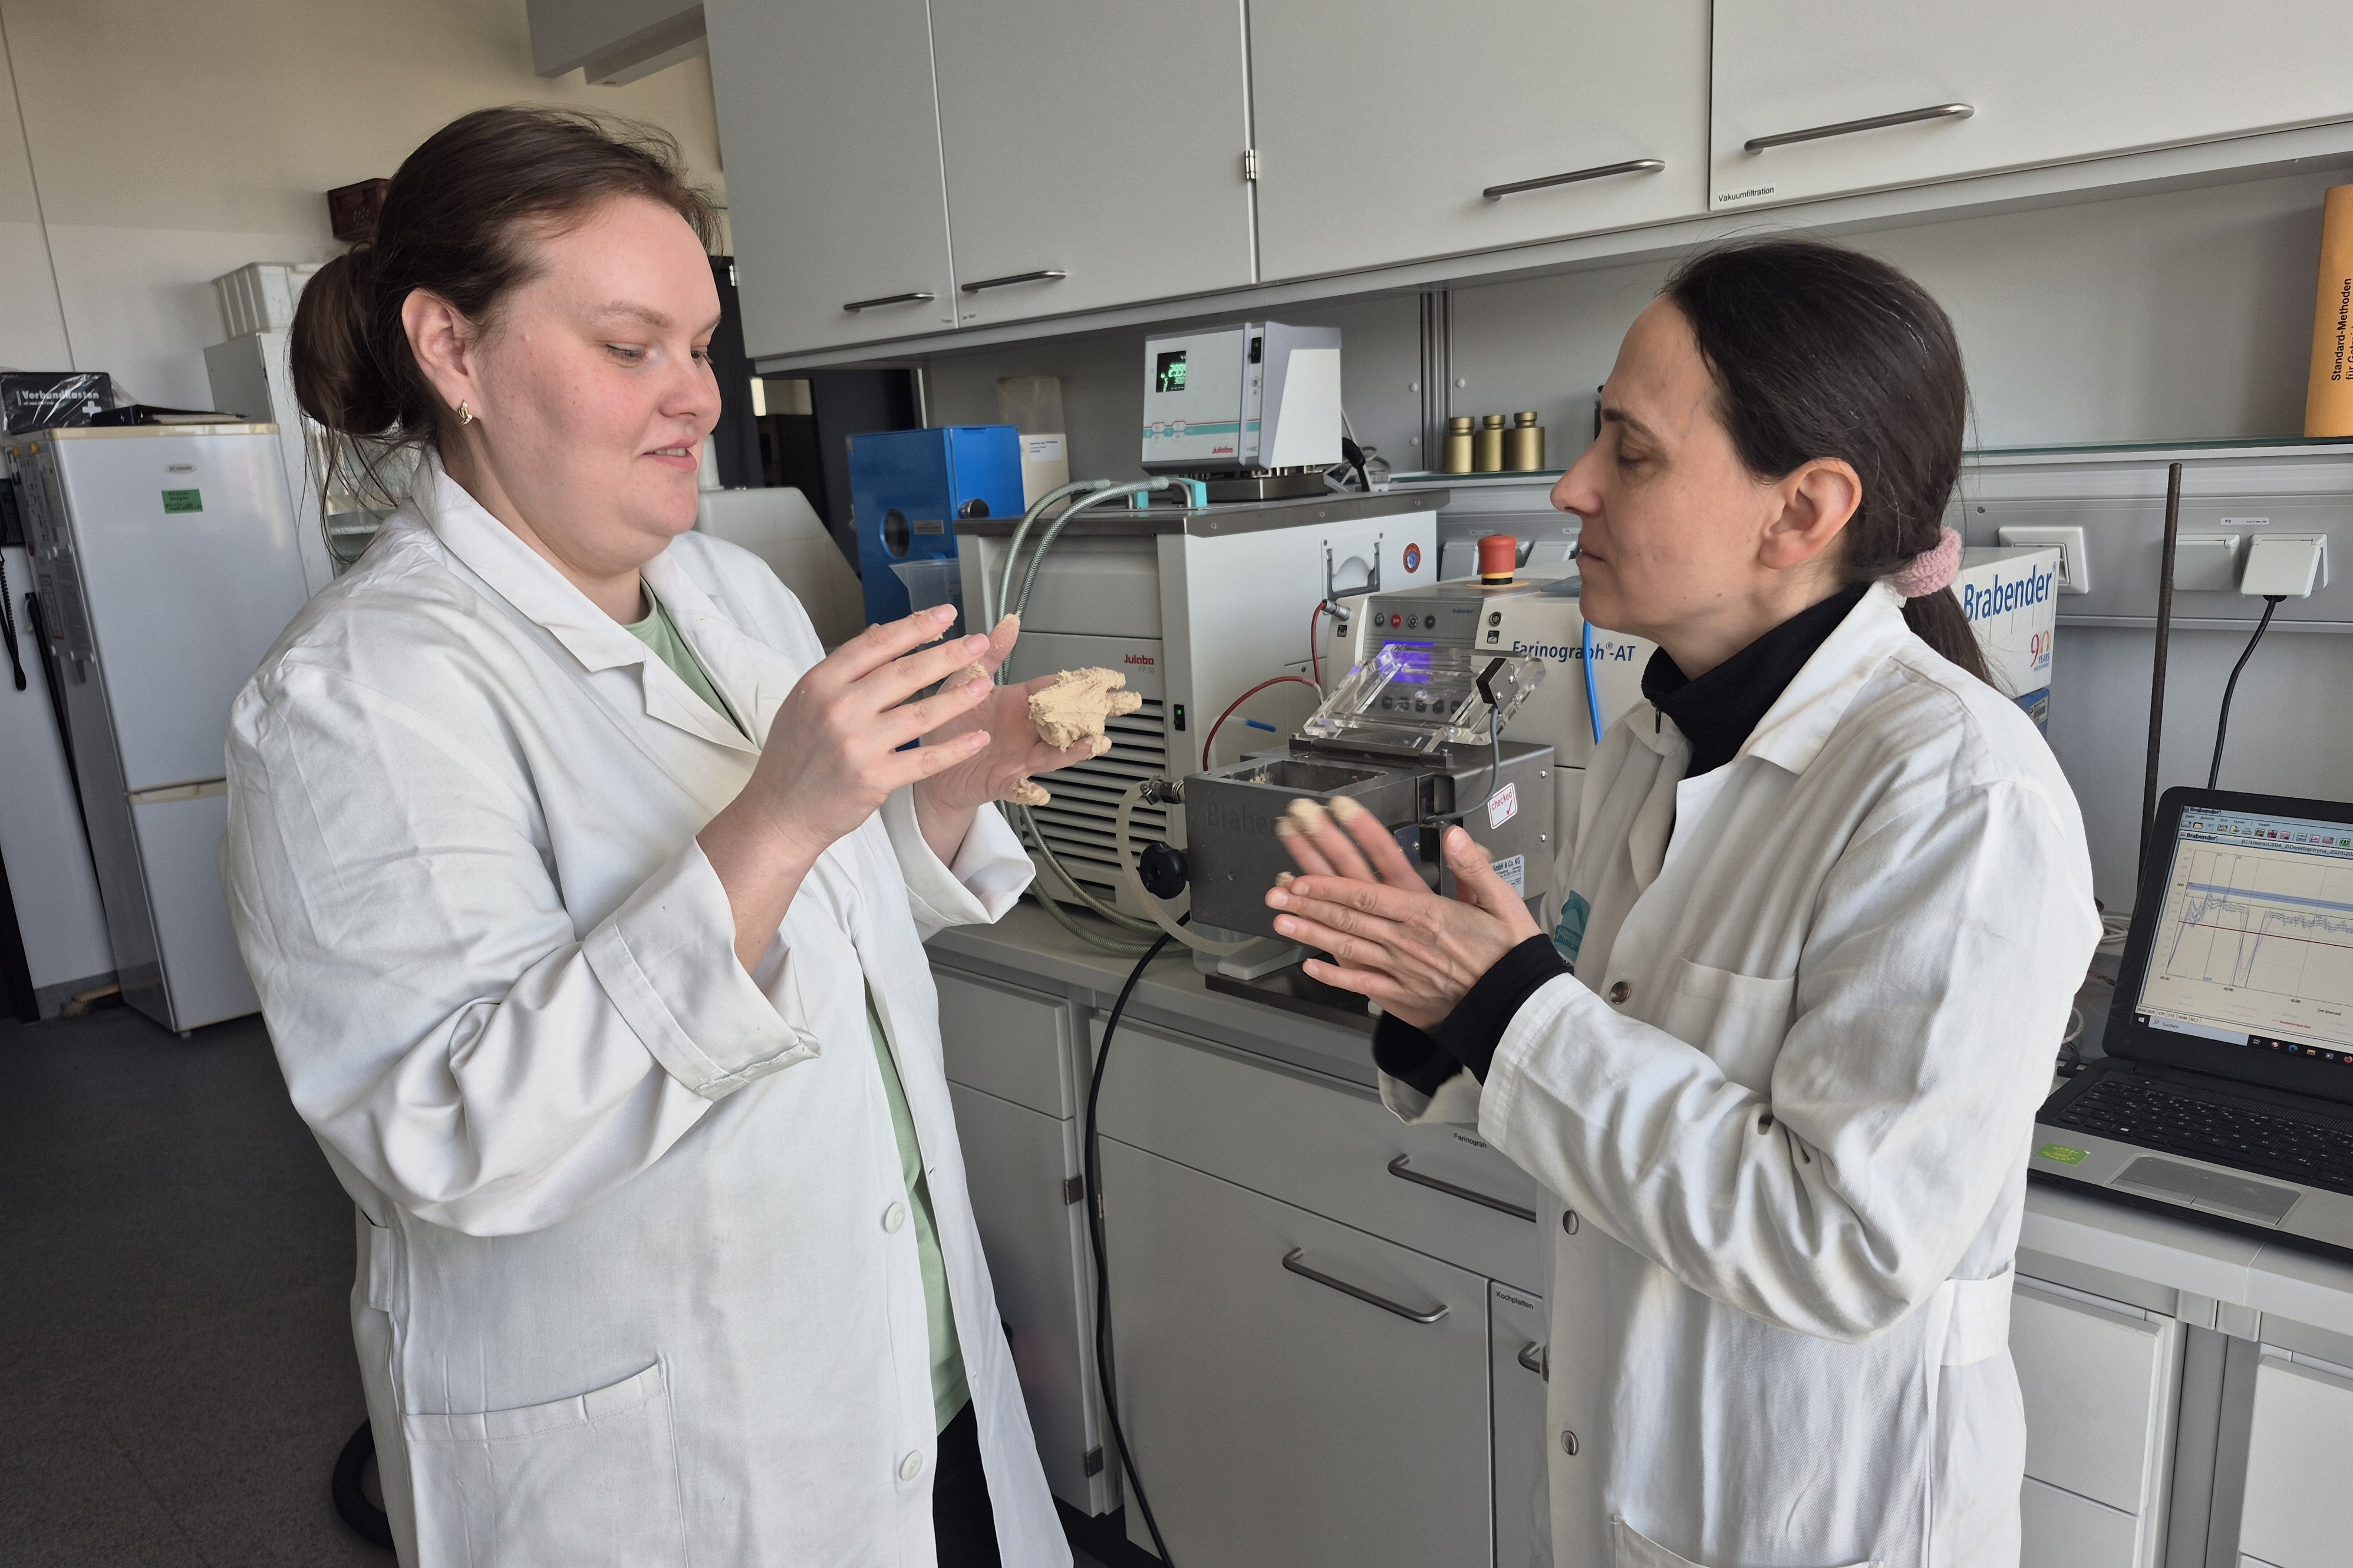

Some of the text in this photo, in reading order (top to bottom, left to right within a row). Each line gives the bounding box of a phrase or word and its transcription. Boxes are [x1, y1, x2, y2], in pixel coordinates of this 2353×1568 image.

[1718, 187, 1774, 202] Vakuumfiltration
[2331, 278, 2352, 381] Standard-Methoden
[1124, 654, 1154, 665] Julabo
[1512, 641, 1636, 663] Farinograh®-AT
[1491, 789, 1512, 811] checked
[1492, 862, 1504, 872] GmbH
[1515, 857, 1521, 865] KG
[1454, 1133, 1487, 1149] Farinograh
[1496, 1290, 1534, 1310] Kochplatten
